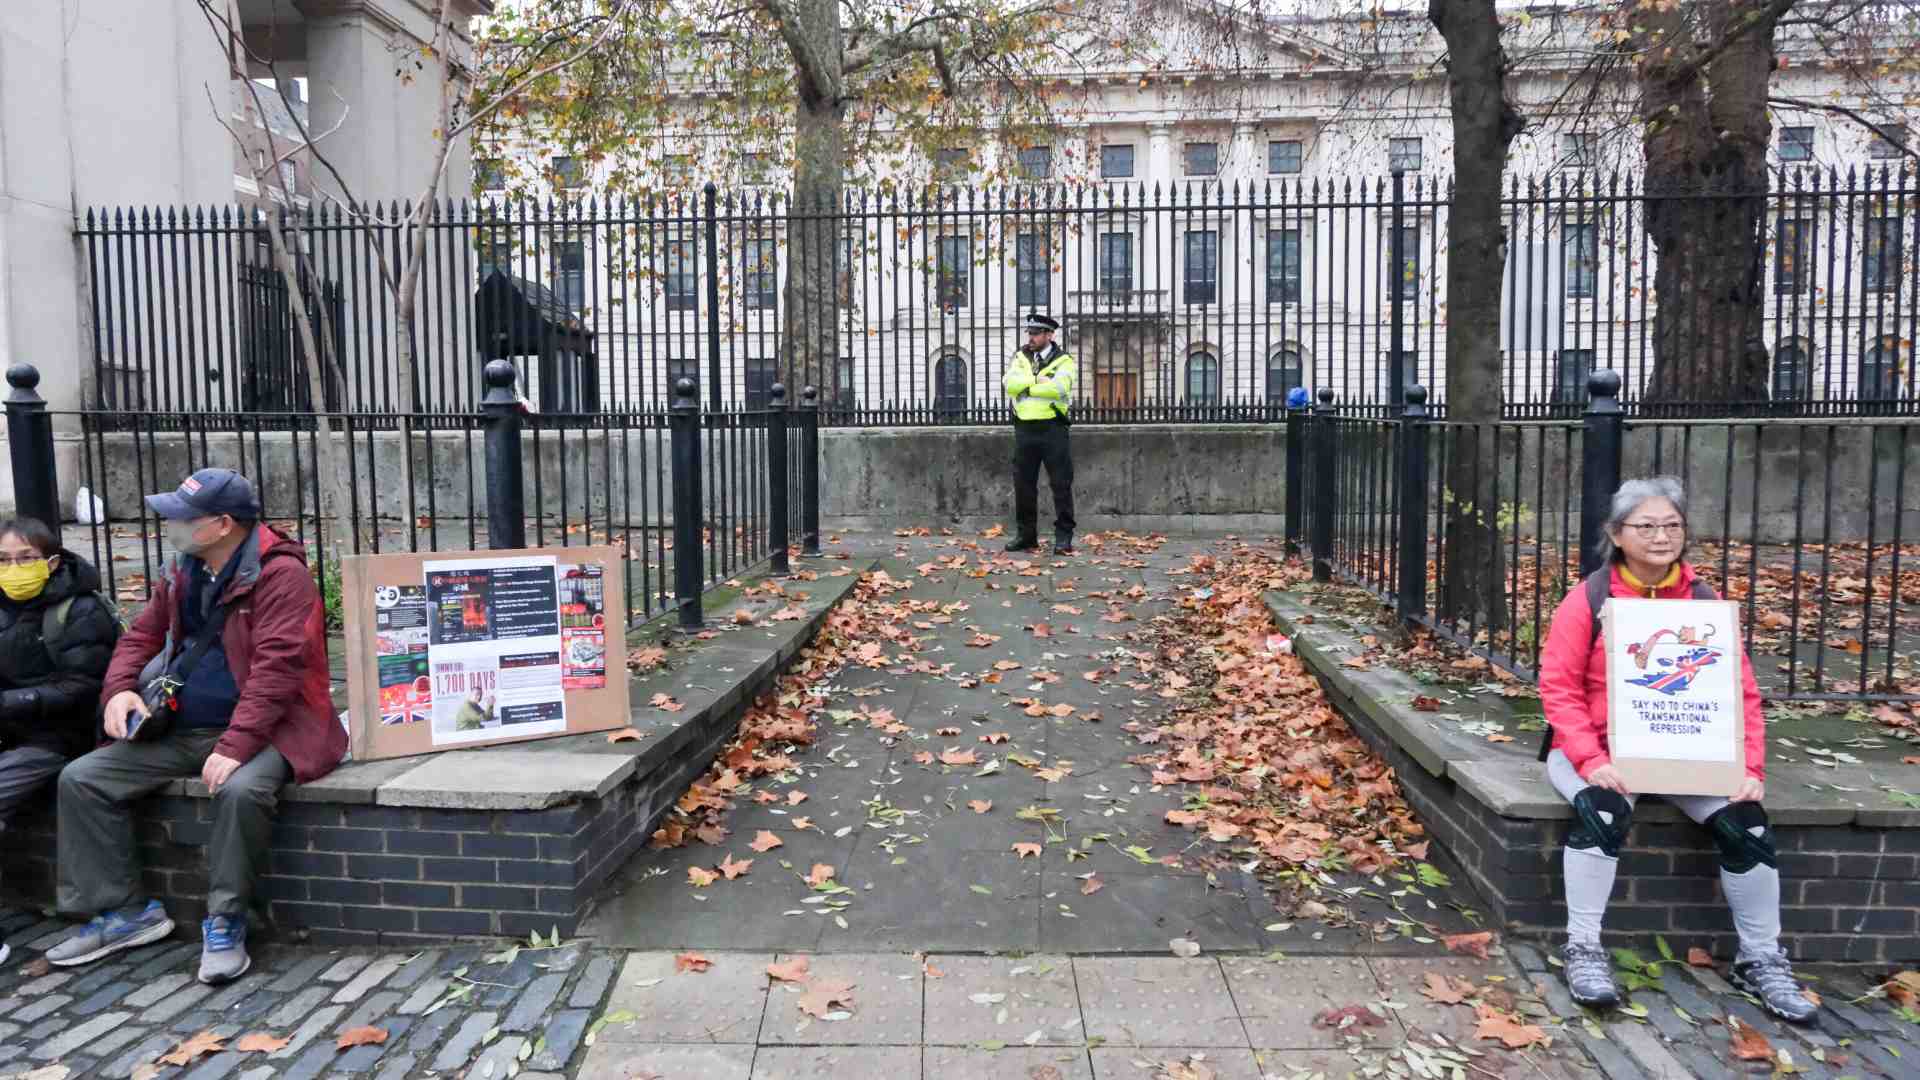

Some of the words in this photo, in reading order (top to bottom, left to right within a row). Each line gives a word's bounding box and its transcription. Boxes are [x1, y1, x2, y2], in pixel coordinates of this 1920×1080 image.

[470, 671, 495, 692] DAYS
[1632, 700, 1649, 709] SAY
[1653, 701, 1665, 710] NO
[1668, 701, 1679, 711] TO
[1682, 701, 1718, 711] CHINA'S
[1639, 711, 1711, 723] TRANSNATIONAL
[1650, 723, 1701, 734] REPRESSION
